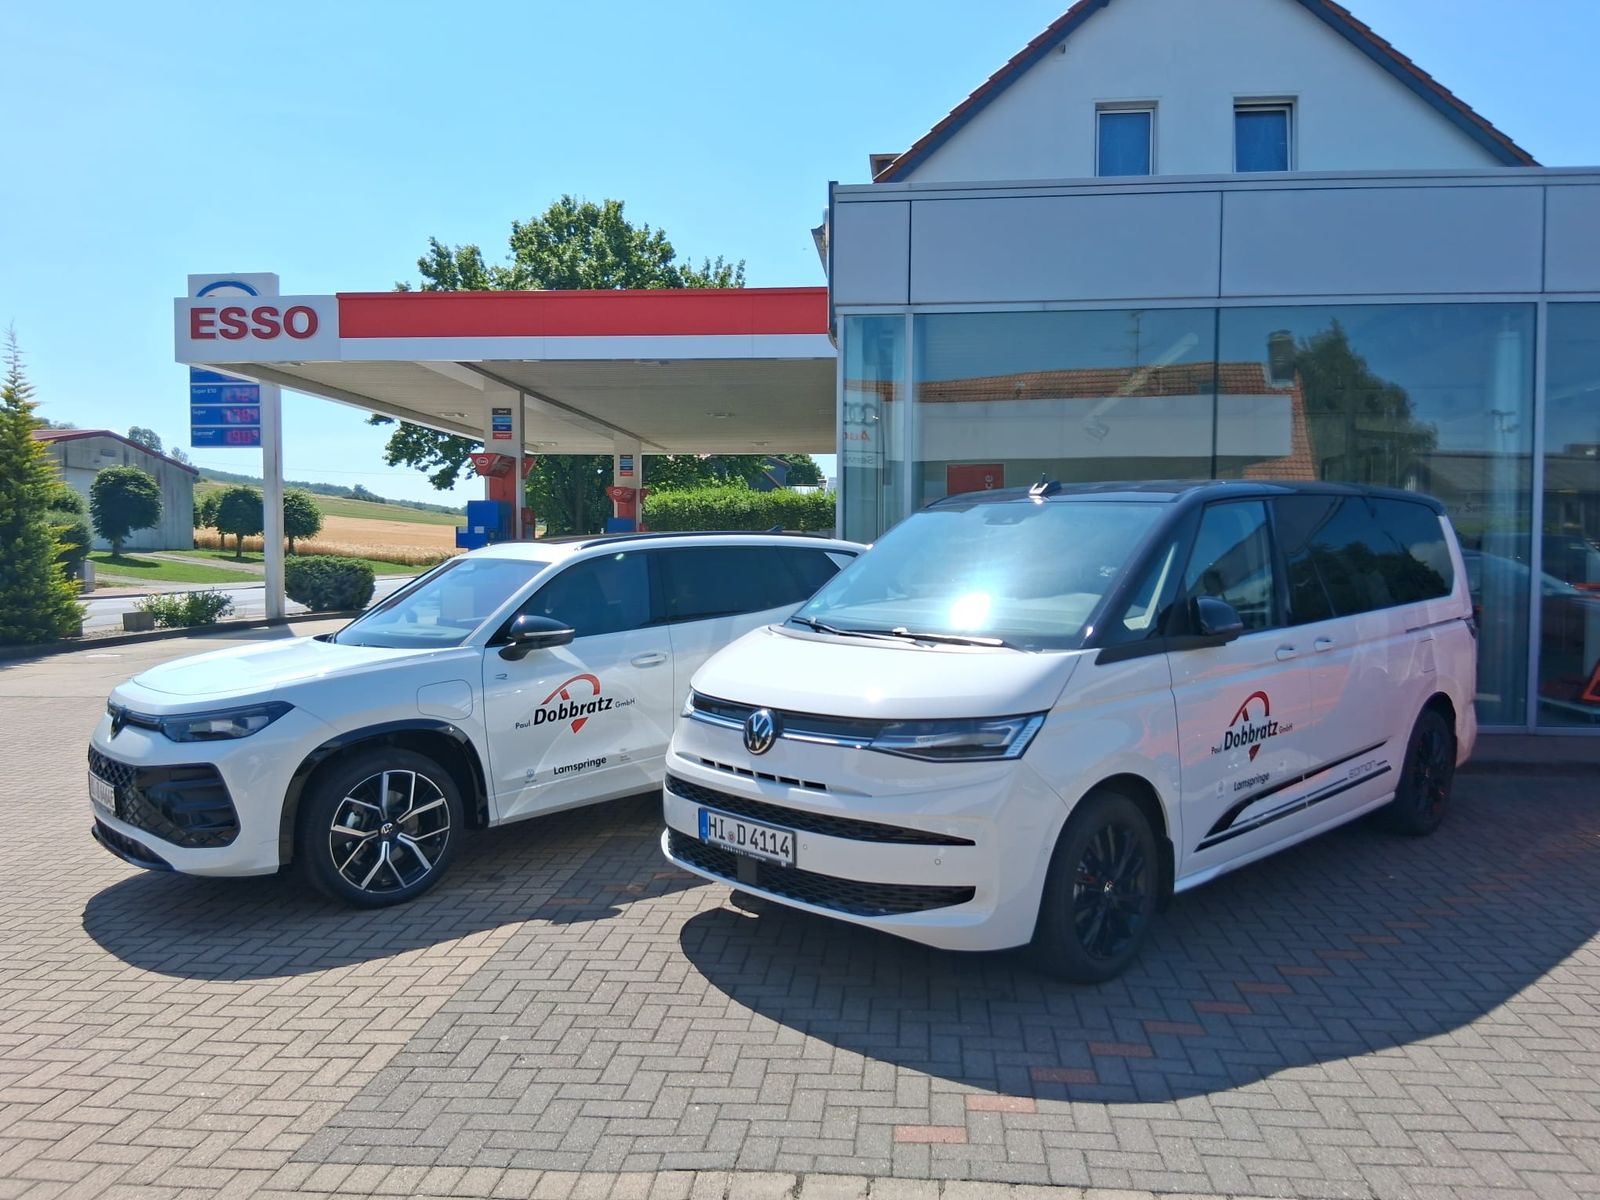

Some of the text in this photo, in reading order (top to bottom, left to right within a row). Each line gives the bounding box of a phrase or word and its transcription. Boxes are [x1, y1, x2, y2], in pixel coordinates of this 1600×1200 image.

[190, 306, 318, 339] ESSO
[515, 697, 636, 729] Paul Dobbratz GmbH
[1211, 720, 1293, 755] Paul Dobbratz GmbH
[553, 757, 607, 775] Lamspringe
[1233, 772, 1270, 792] Lamspringe
[708, 815, 726, 840] HI
[737, 823, 747, 846] D
[750, 828, 790, 858] 4114
